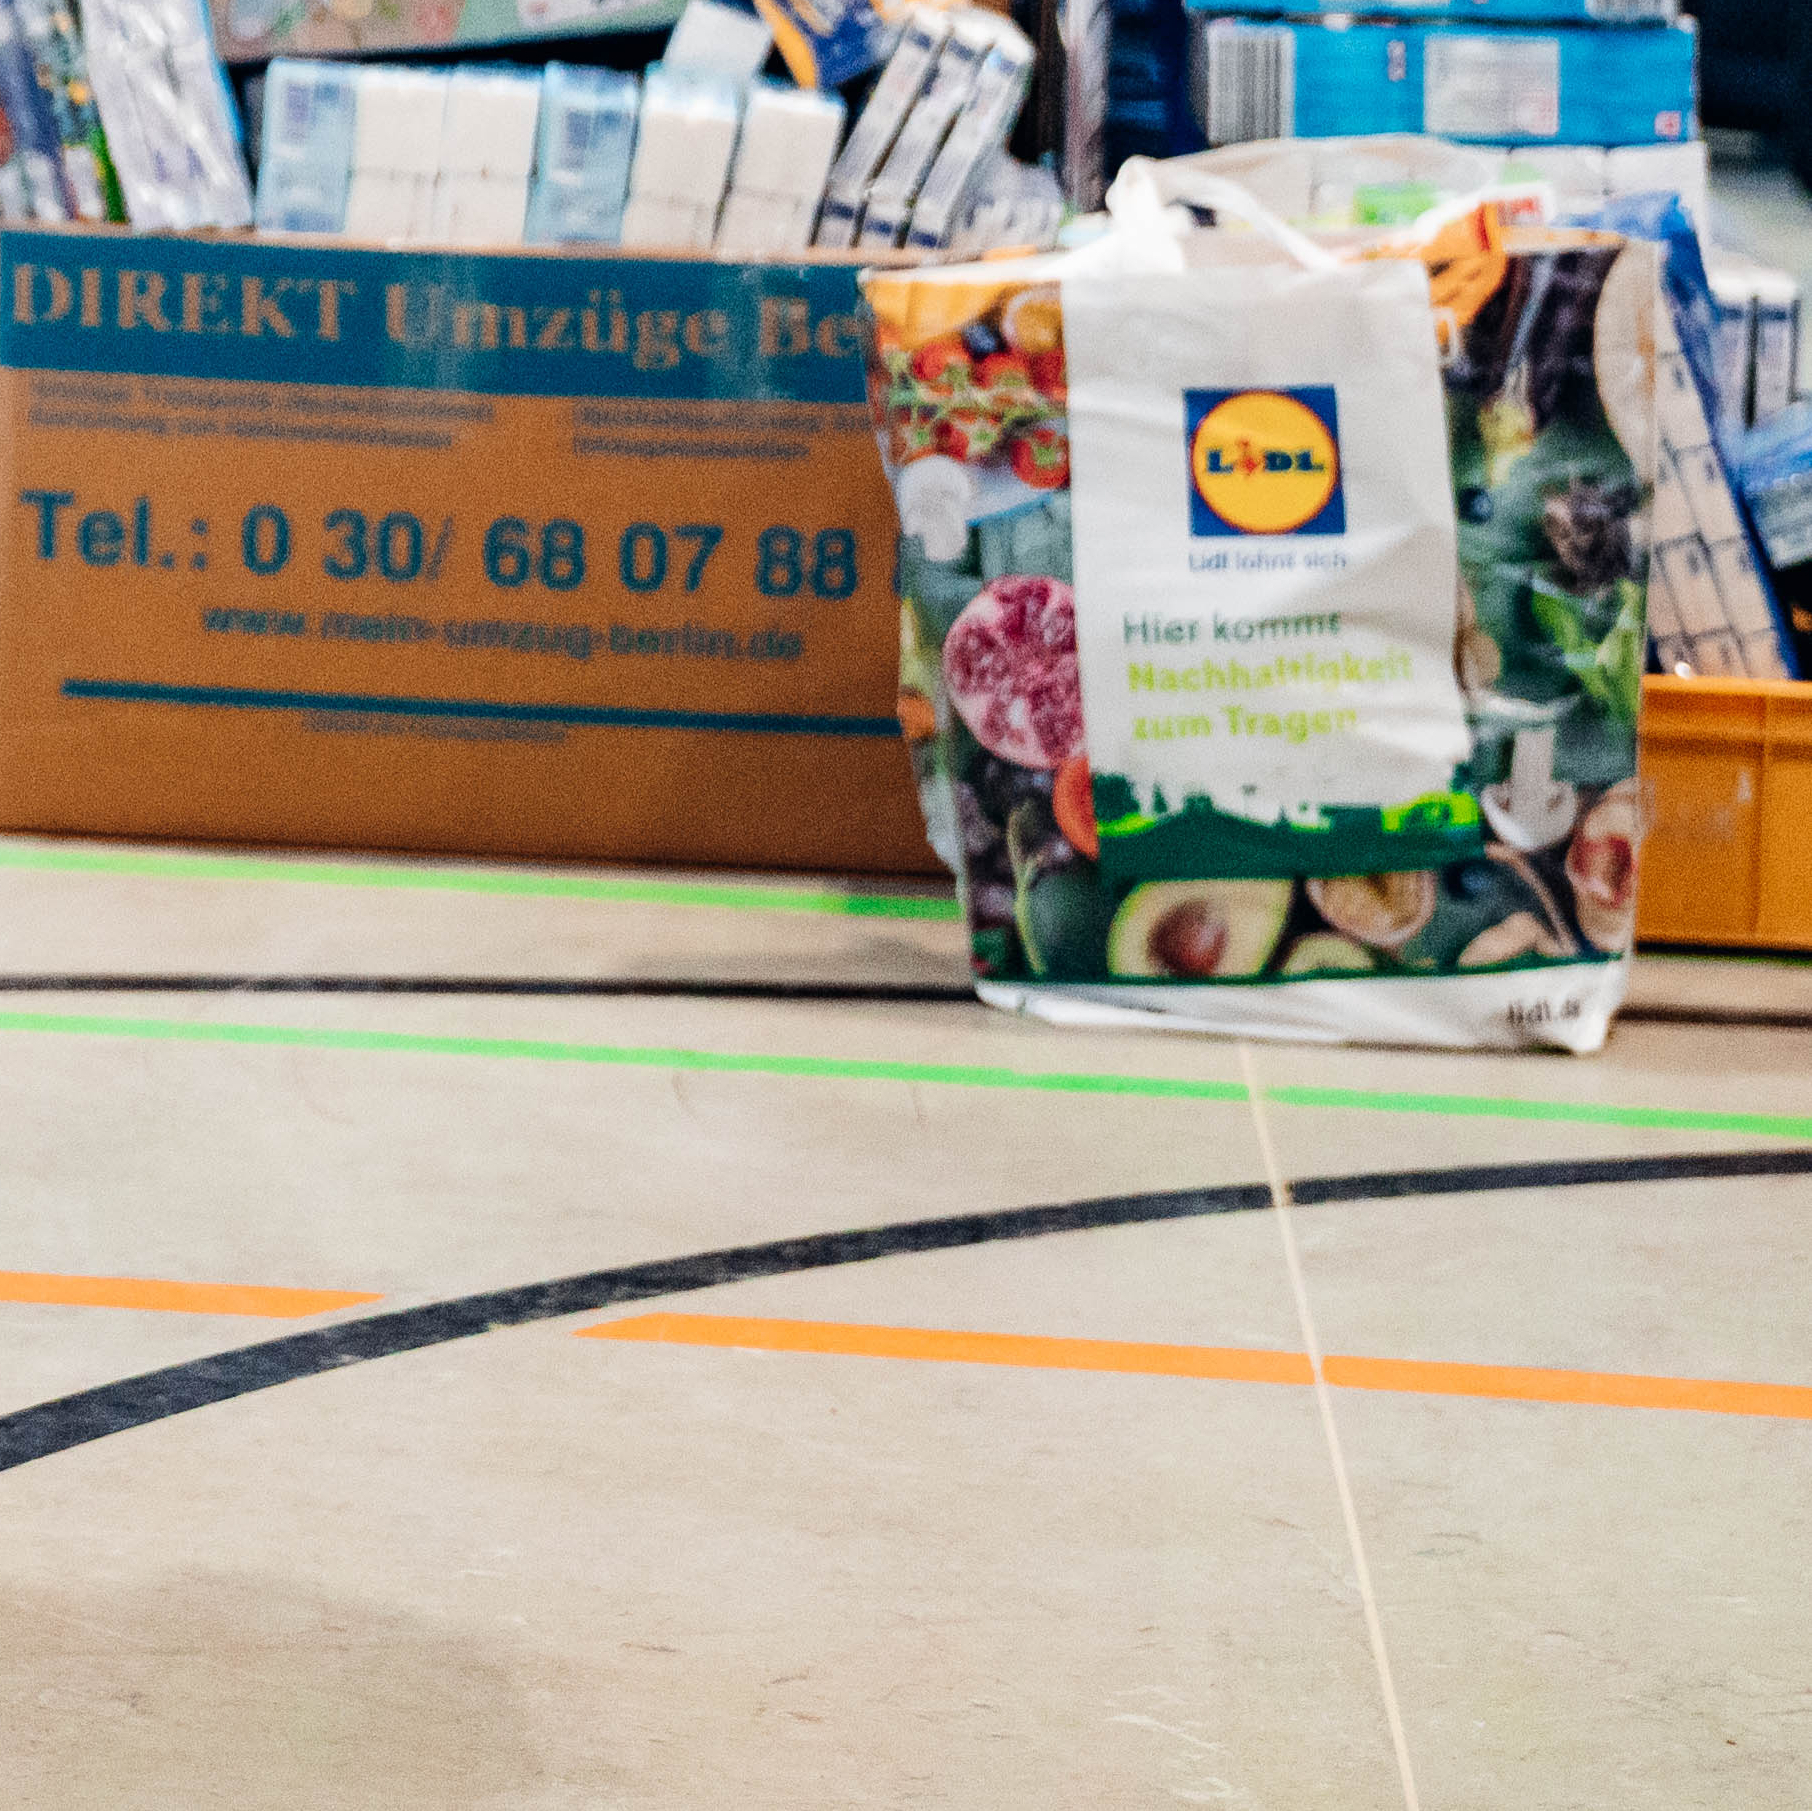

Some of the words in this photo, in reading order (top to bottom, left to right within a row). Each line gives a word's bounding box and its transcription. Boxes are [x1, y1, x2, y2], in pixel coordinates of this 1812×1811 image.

[12, 261, 359, 342] DIREKT
[384, 282, 730, 371] Umzüge
[19, 490, 209, 572] Tel.:
[240, 503, 292, 576] 0
[482, 515, 587, 592] 68
[618, 521, 725, 595] 07
[754, 524, 860, 601] 88
[1123, 611, 1201, 644] Hier
[1212, 609, 1342, 644] kommt
